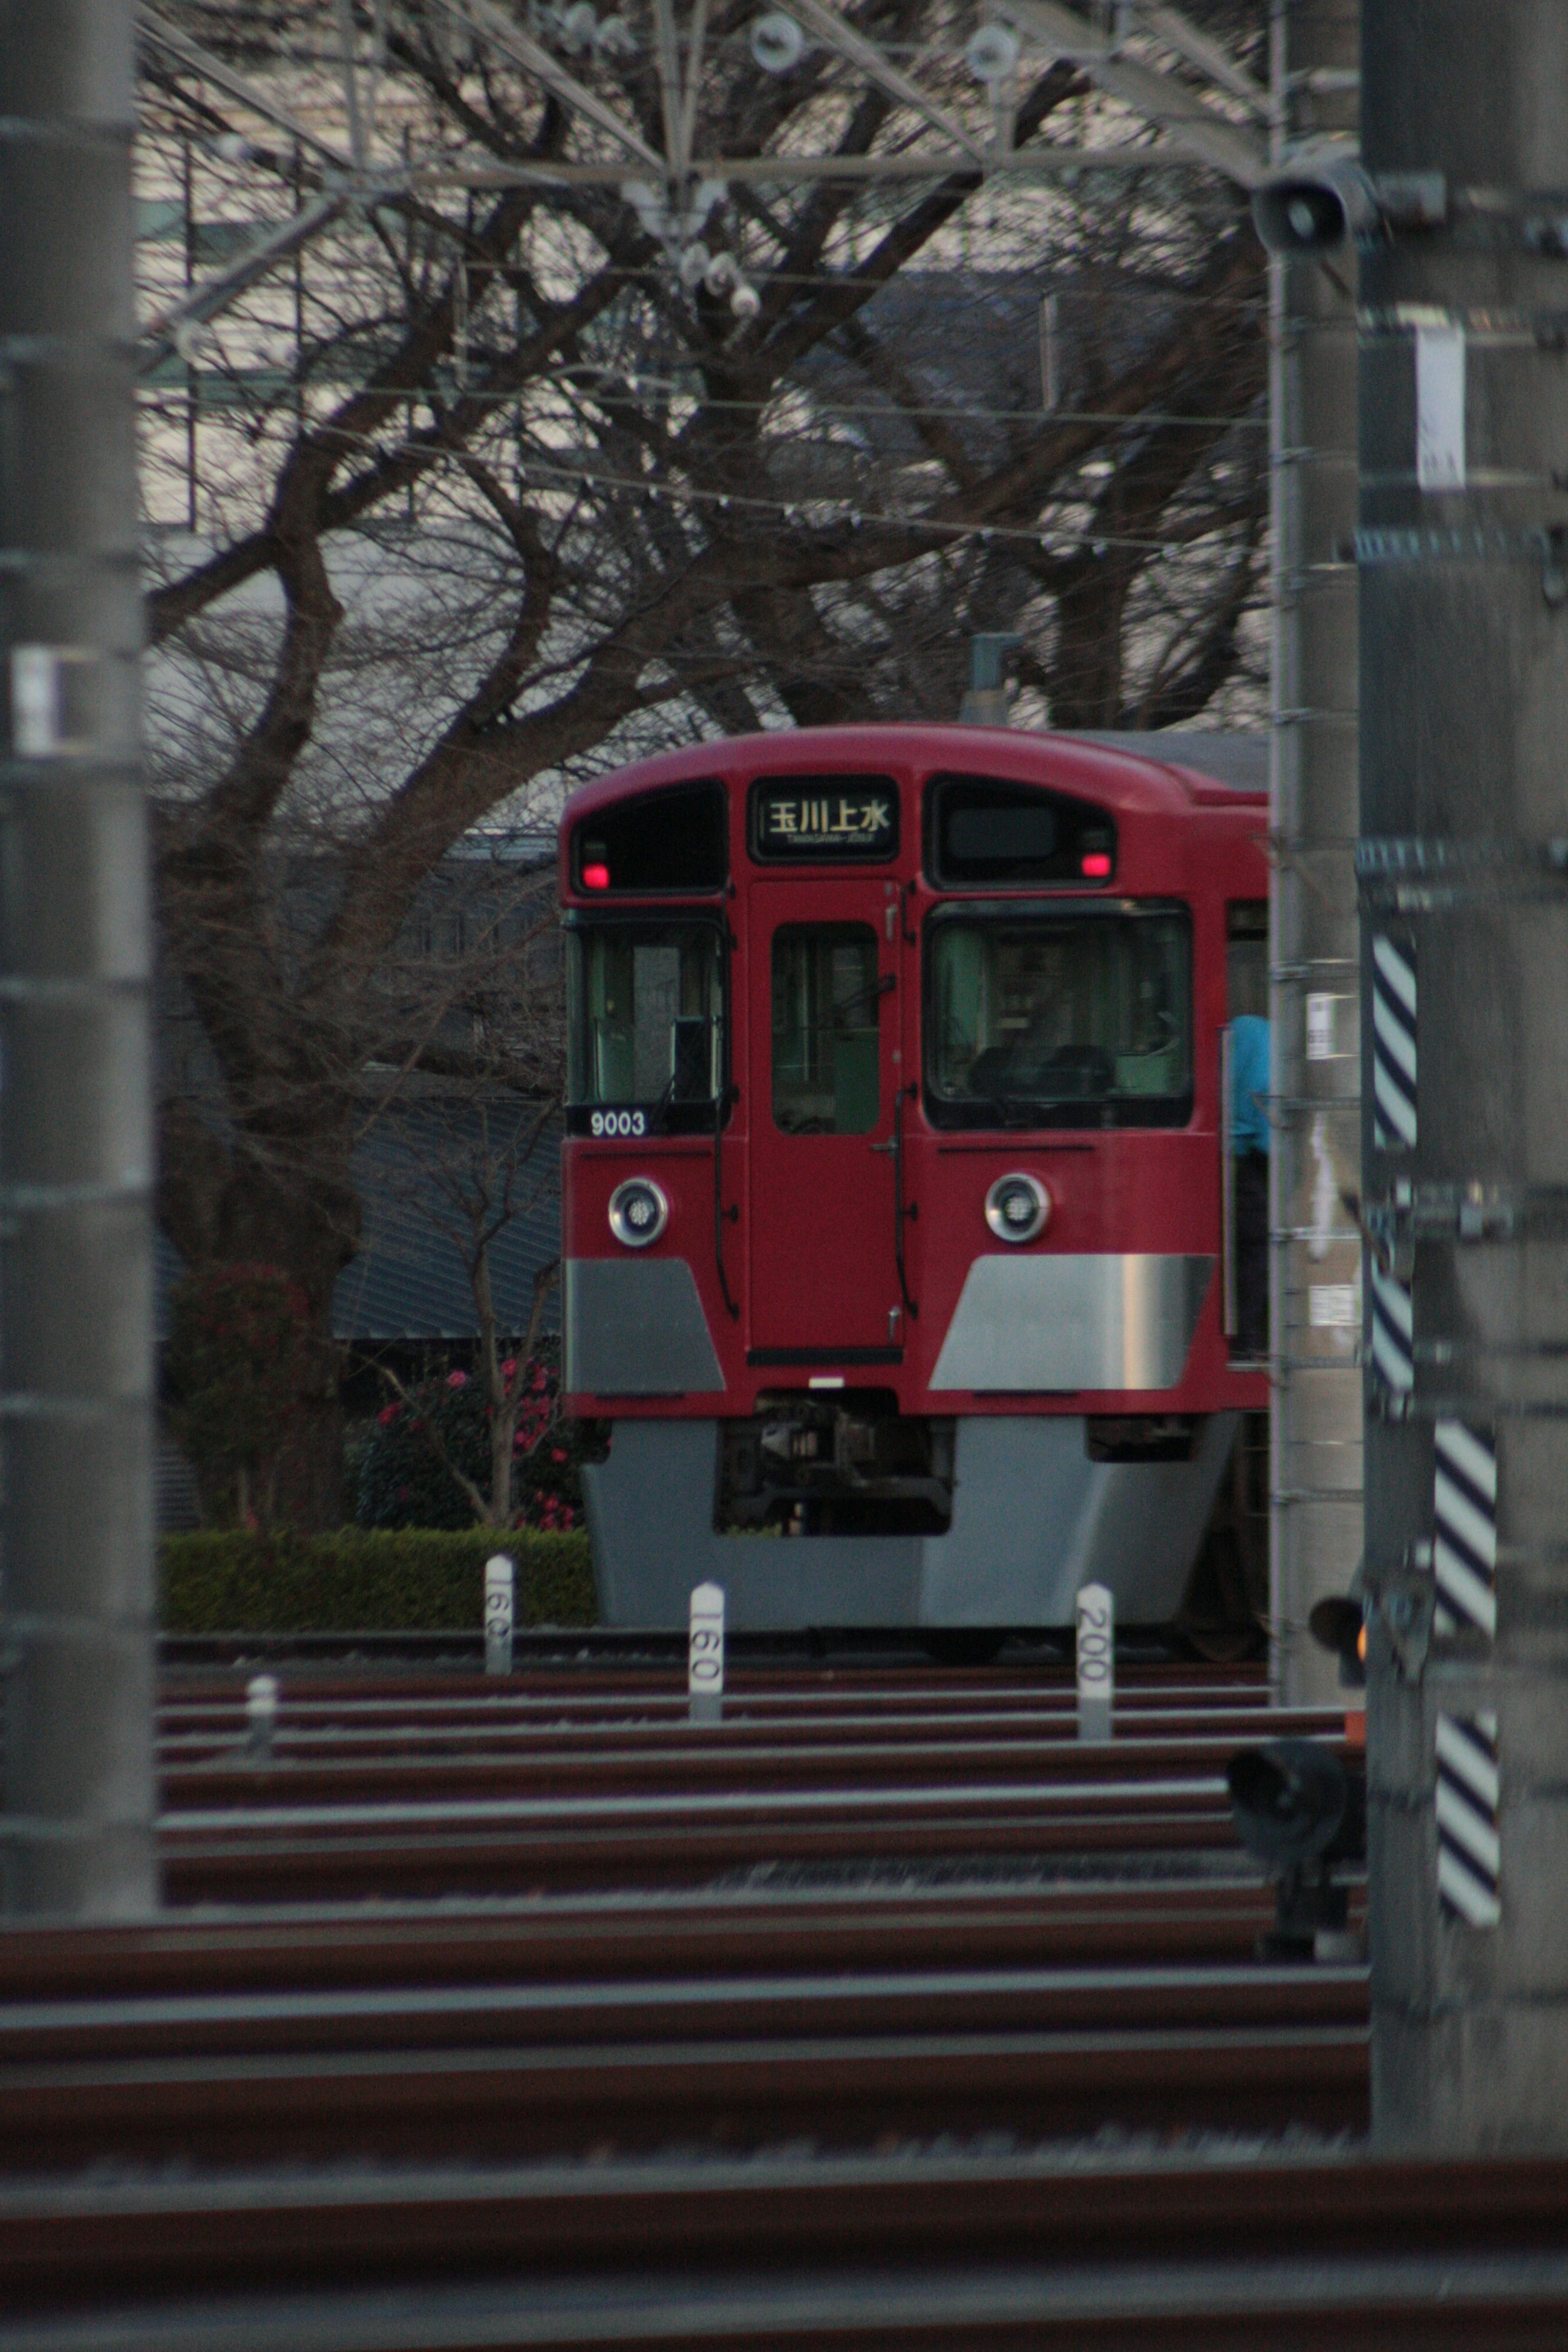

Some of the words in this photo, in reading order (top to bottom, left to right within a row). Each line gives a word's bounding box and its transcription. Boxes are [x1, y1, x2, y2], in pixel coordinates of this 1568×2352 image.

[769, 799, 890, 833] 玉川上水
[591, 1111, 645, 1135] 9003
[486, 1579, 513, 1638] 160
[692, 1613, 721, 1680] 160
[1077, 1607, 1111, 1682] 200
